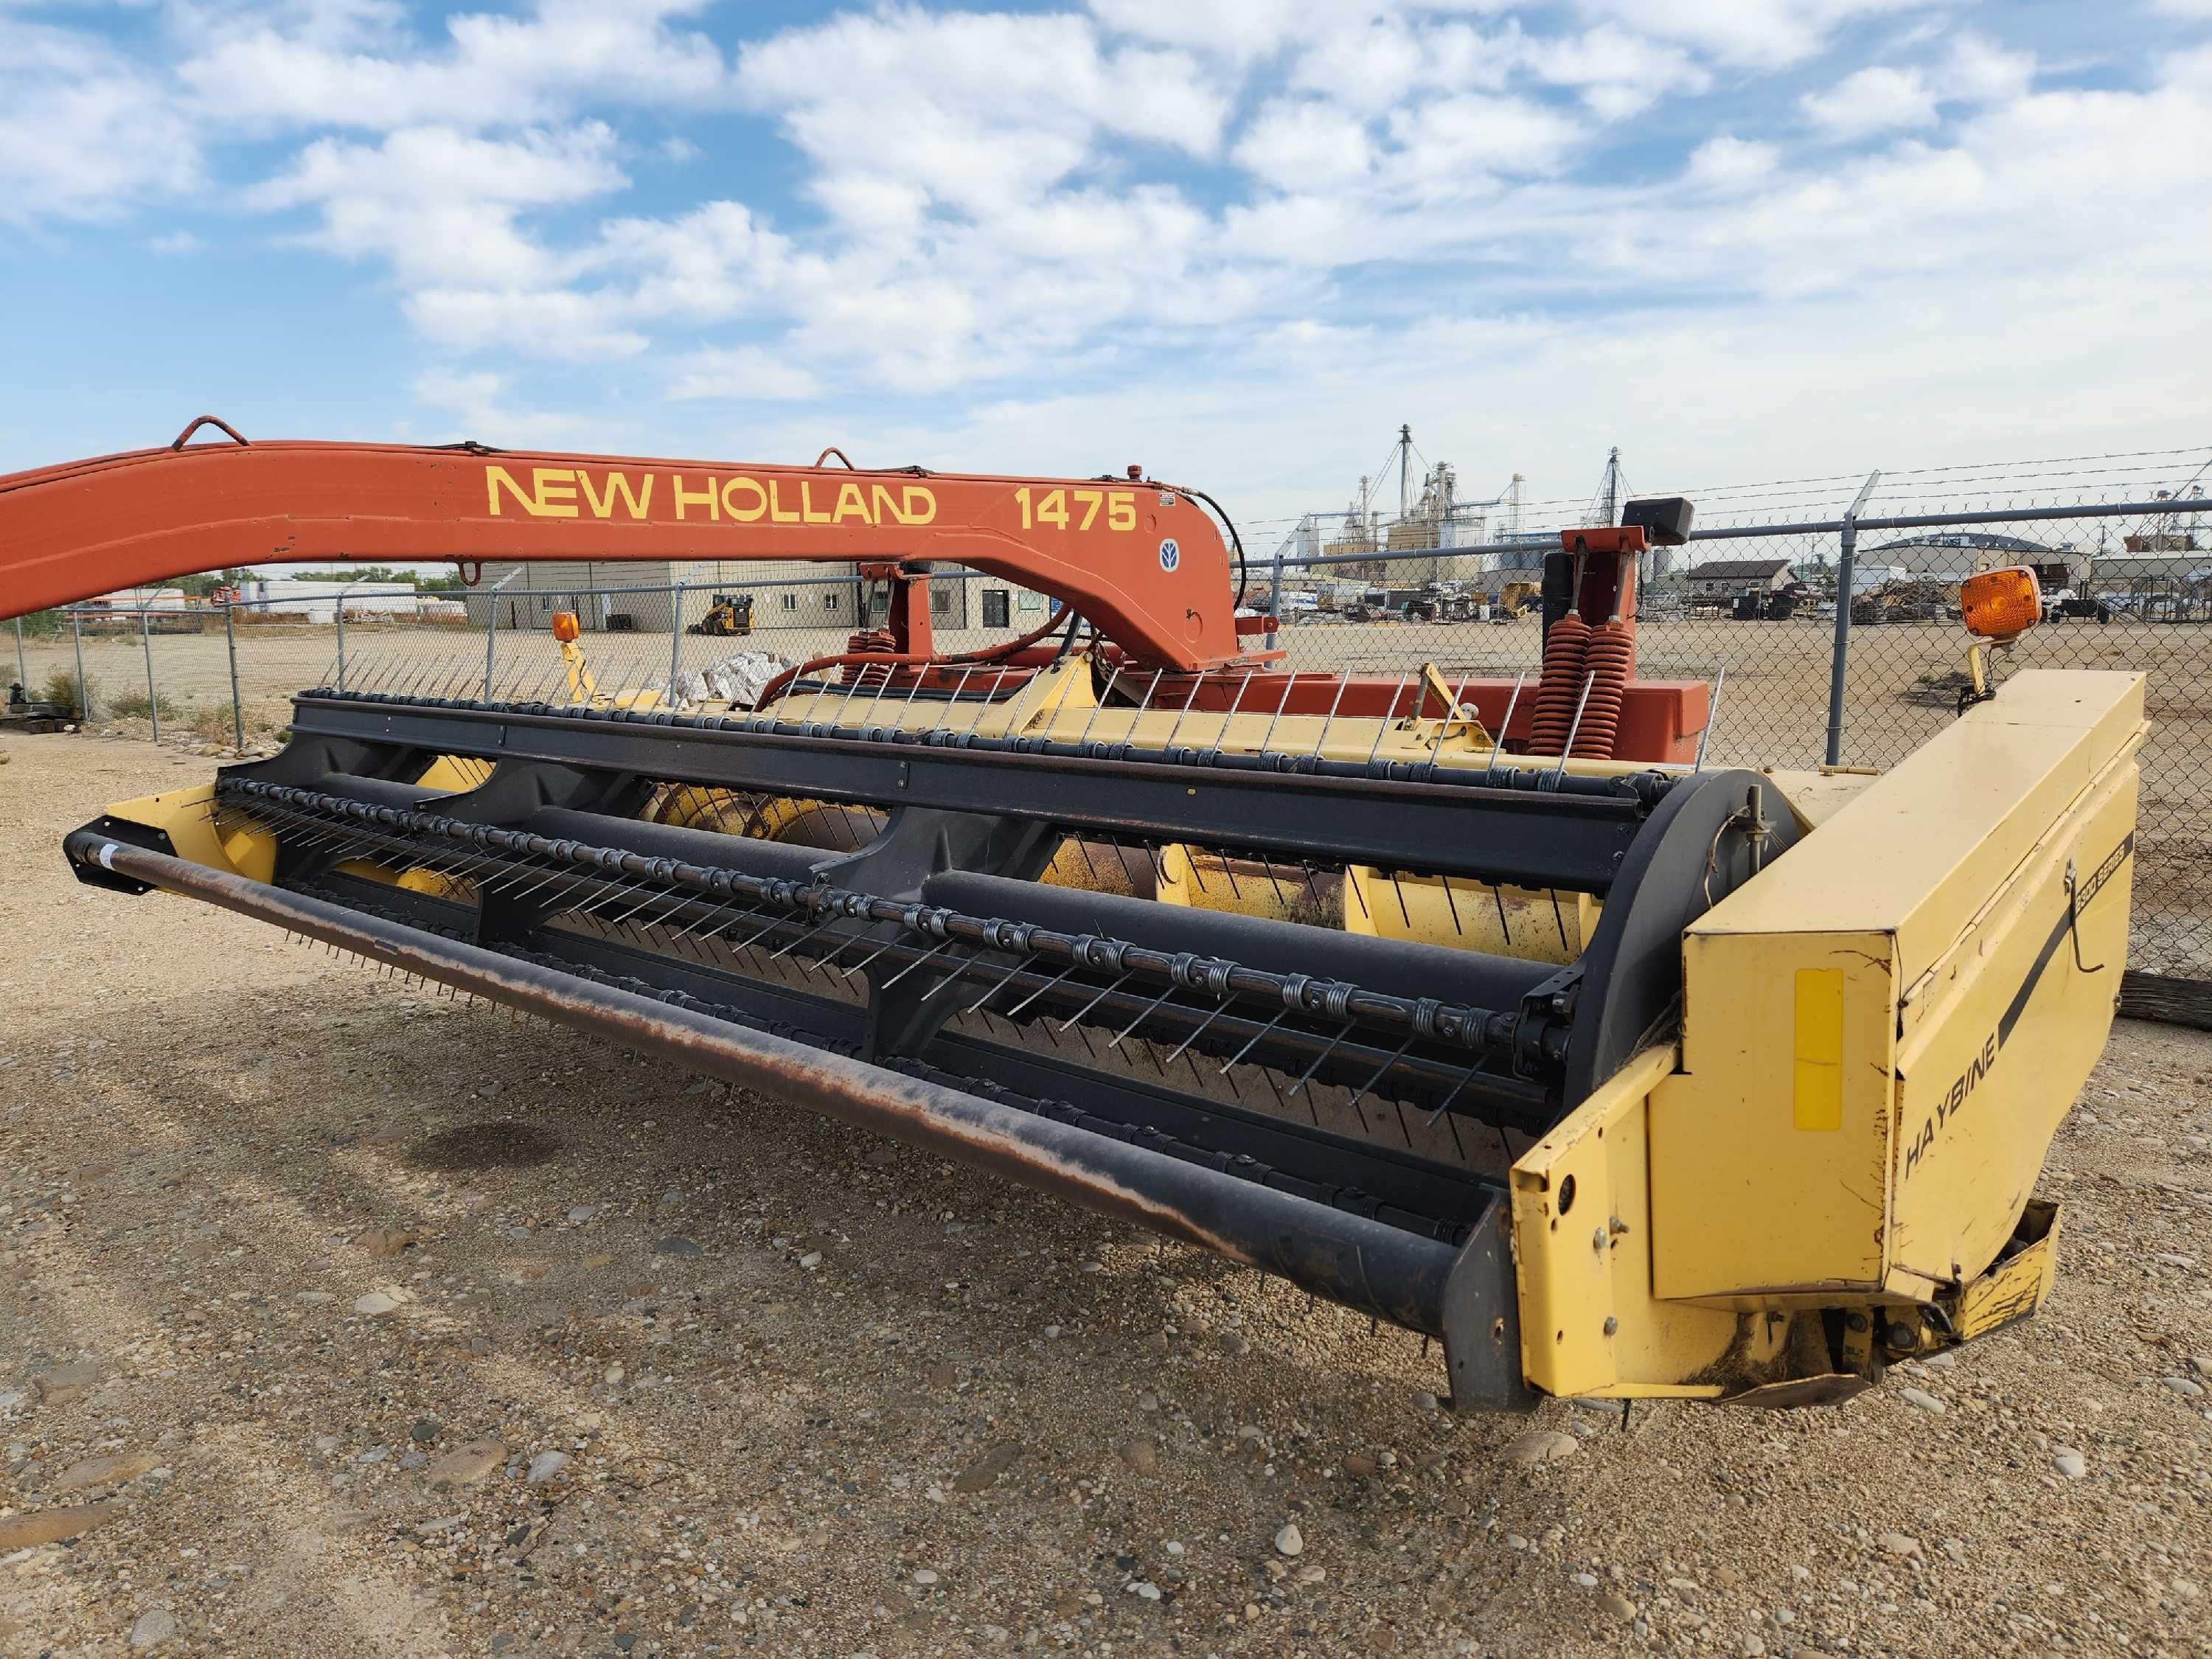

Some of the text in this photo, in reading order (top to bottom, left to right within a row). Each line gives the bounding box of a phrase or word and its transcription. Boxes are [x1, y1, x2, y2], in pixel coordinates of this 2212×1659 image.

[485, 465, 936, 525] NEW HOLLAND
[1015, 487, 1136, 531] 1475
[2098, 844, 2124, 887] SERIES
[1905, 1032, 1994, 1180] HAYBINE
